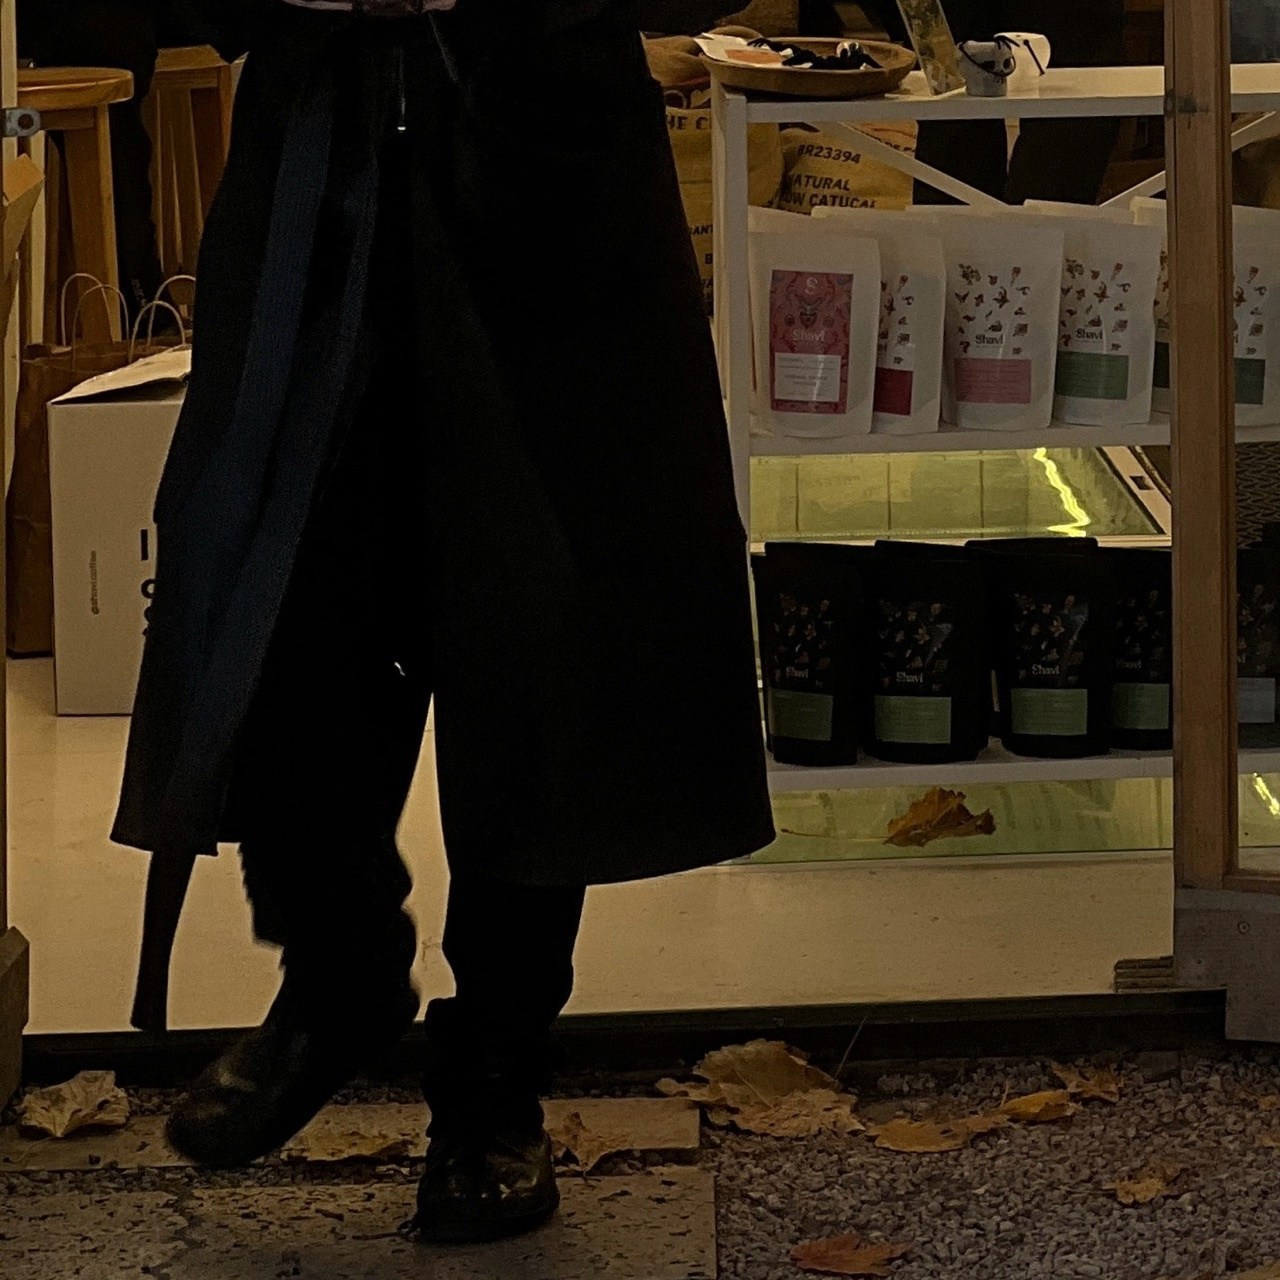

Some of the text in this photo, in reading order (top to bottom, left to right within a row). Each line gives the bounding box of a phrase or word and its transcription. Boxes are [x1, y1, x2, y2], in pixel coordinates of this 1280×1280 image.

[975, 333, 1004, 345] Shavi
[1075, 327, 1104, 340] Shavi
[1031, 663, 1060, 676] Shavi
[895, 671, 924, 684] Shavi
